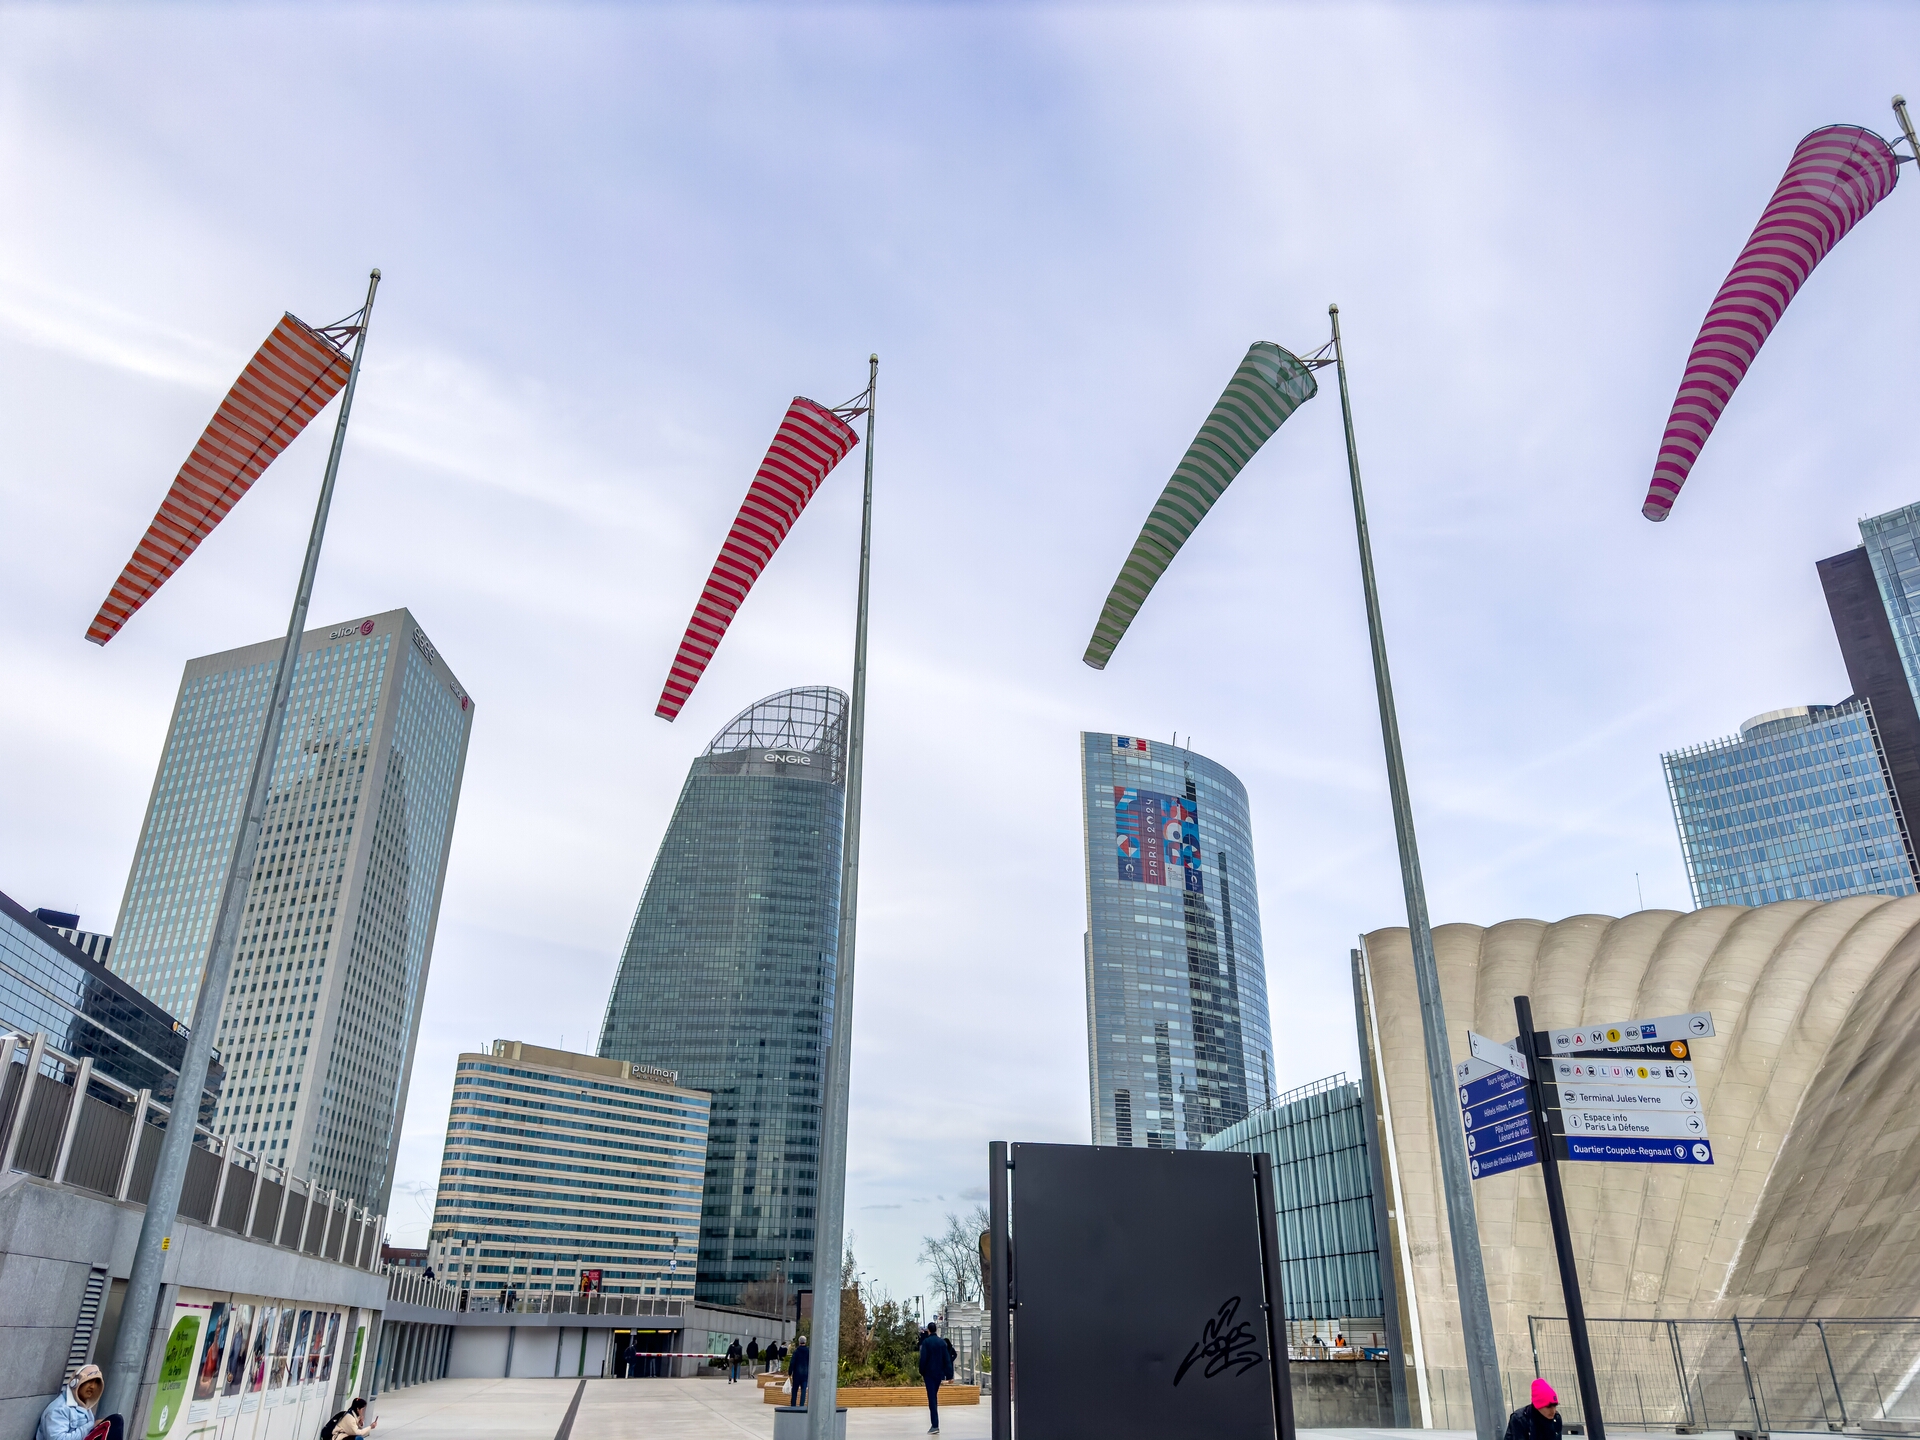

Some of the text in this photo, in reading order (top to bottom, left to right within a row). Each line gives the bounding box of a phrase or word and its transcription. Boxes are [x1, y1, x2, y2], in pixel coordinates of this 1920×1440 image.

[329, 624, 360, 640] elior
[1146, 799, 1155, 833] 2024
[1592, 1034, 1602, 1042] M
[632, 1064, 678, 1082] pullman
[1580, 1094, 1661, 1103] Terminal Jules Verne
[1584, 1113, 1611, 1123] Espace
[1612, 1114, 1628, 1122] info
[1520, 1126, 1530, 1136] Vinci
[1585, 1123, 1649, 1132] Paris La Défense
[1574, 1145, 1604, 1154] Quartier
[1606, 1146, 1672, 1157] Coupole-Regnault
[1481, 1160, 1494, 1170] Maison
[1517, 1150, 1533, 1160] Défense
